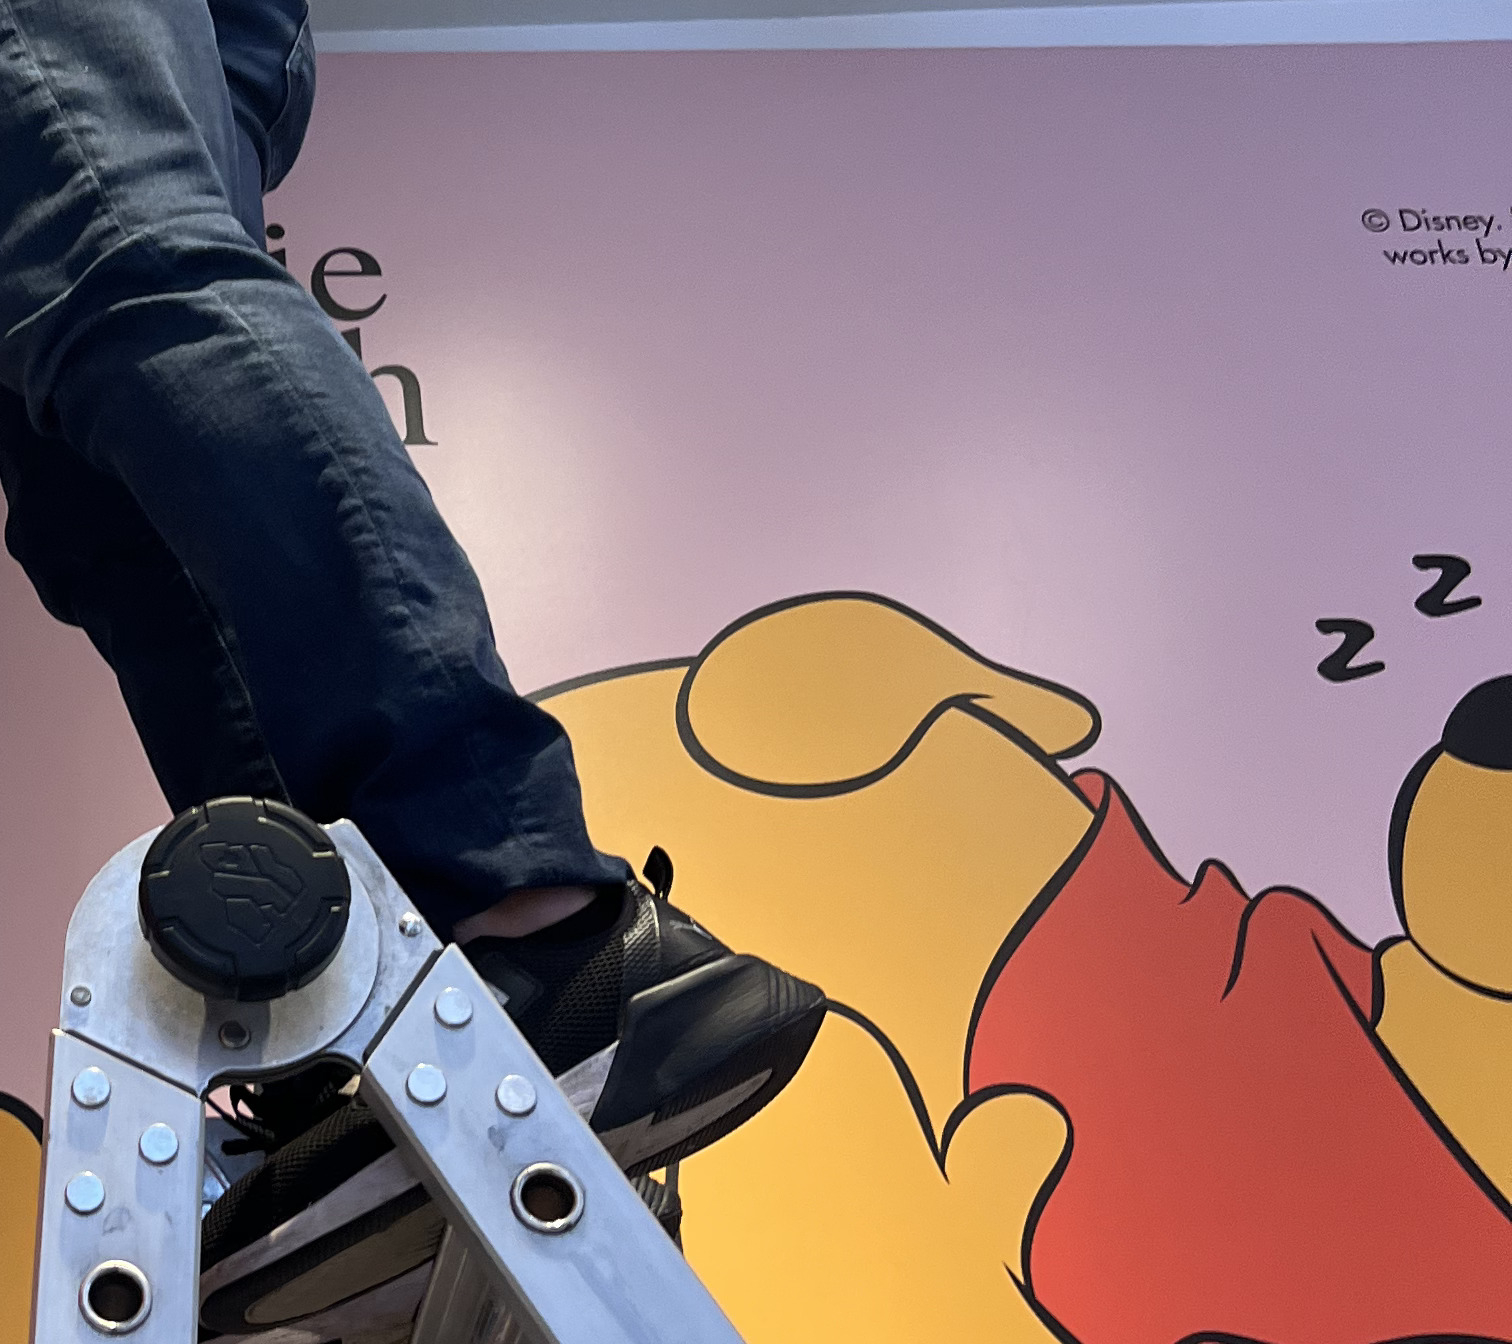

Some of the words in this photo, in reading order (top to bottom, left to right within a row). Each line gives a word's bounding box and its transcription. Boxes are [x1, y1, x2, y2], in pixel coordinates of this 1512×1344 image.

[1399, 208, 1503, 238] Disney.
[1383, 239, 1470, 265] works
[1476, 238, 1512, 271] by
